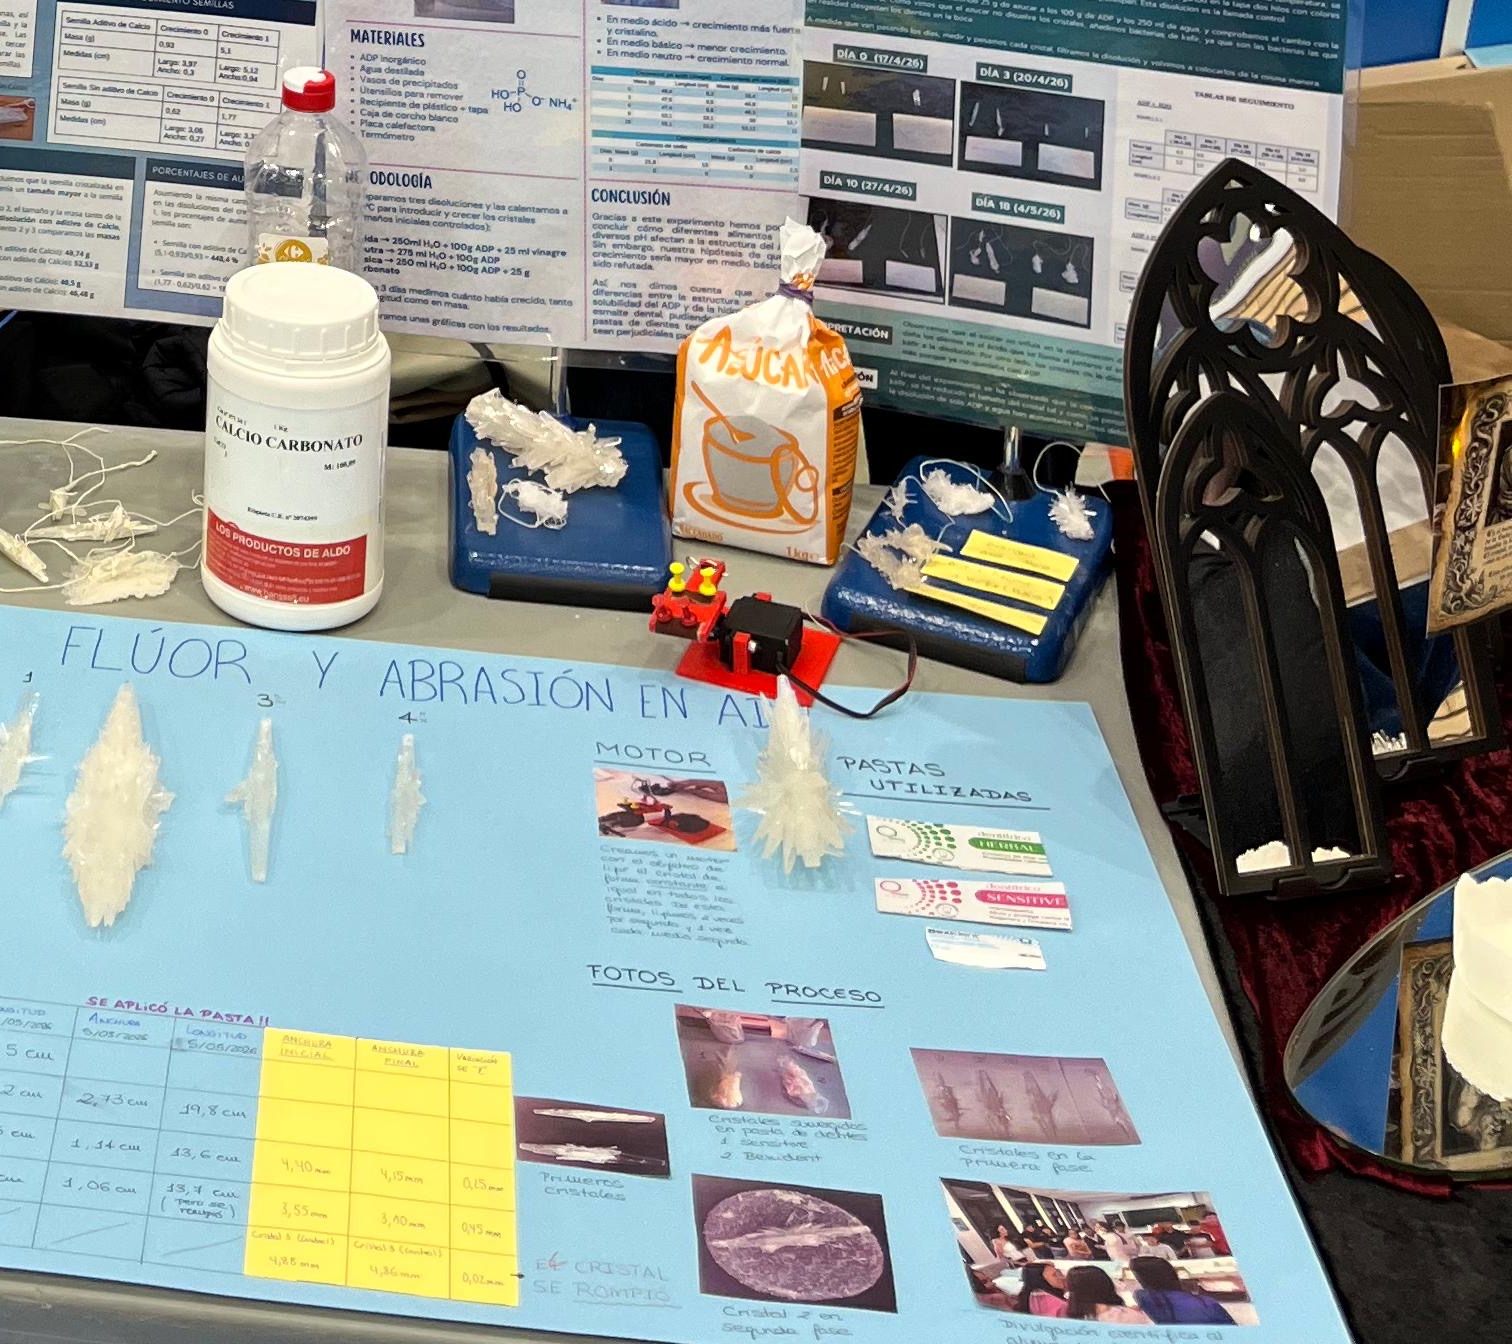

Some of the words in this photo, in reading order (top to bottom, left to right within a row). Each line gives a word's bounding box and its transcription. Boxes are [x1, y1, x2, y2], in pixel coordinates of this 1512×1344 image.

[591, 188, 670, 206] CONCLUSIÓN
[215, 414, 263, 447] CALCIO
[265, 433, 364, 453] CARBONATO
[61, 625, 251, 684] FLÚOR
[313, 651, 339, 688] Y
[380, 658, 613, 712] ABRASIÓN
[640, 684, 689, 721] EN
[596, 741, 712, 767] MOTOR
[836, 756, 946, 778] PASTAS
[587, 964, 676, 987] FOTOS
[692, 977, 746, 993] DEL
[765, 982, 883, 1004] PROCESO
